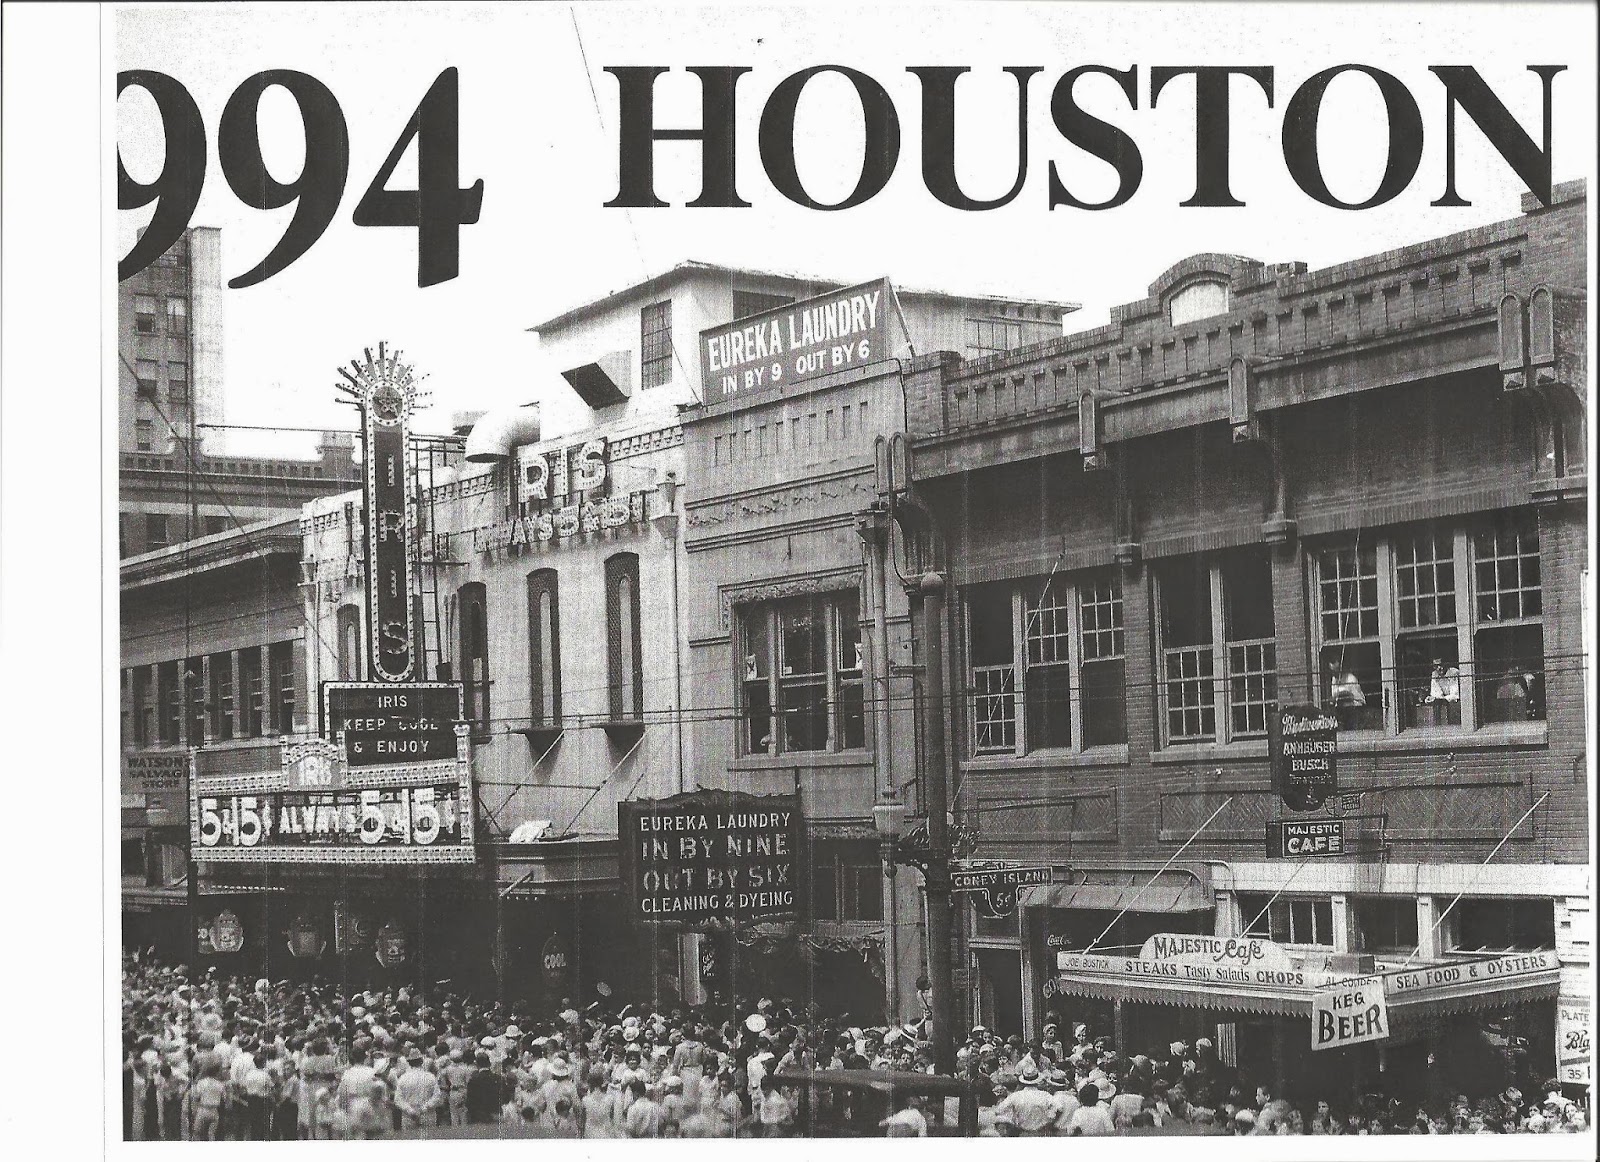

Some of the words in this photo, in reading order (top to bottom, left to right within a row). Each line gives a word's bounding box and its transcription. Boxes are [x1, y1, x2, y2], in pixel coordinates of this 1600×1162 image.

[708, 320, 783, 372] EUREKA
[788, 291, 880, 350] LAUNDRY
[722, 374, 738, 395] IN
[745, 367, 765, 390] BY
[771, 363, 782, 382] 9
[795, 350, 826, 375] OUT
[832, 342, 855, 367] BY
[858, 339, 870, 360] 6
[378, 695, 408, 709] IRIS
[343, 718, 386, 732] KEEP
[353, 741, 363, 753] &
[376, 740, 430, 753] ENJOY
[1283, 740, 1336, 755] ANHEUSER
[1291, 758, 1329, 771] BUSCH
[640, 815, 709, 832] EUREKA
[717, 812, 791, 830] LAUNDRY
[1288, 824, 1340, 835] MAJESTIC
[642, 837, 669, 861] IN
[679, 836, 713, 859] BY
[726, 833, 790, 857] NINE
[1288, 835, 1341, 853] CAFE
[643, 867, 696, 892] OUT
[706, 867, 739, 890] BY
[748, 862, 790, 888] SIX
[954, 873, 998, 887] CONEY
[1003, 870, 1049, 884] ISLAND
[641, 894, 719, 913] CLEANING
[724, 894, 735, 908] &
[739, 890, 793, 908] DYEING
[1153, 936, 1222, 960] MAJESTIC
[1125, 960, 1178, 976] STEAKS
[1184, 964, 1211, 980] Tasty
[1216, 966, 1250, 981] Salads
[1256, 970, 1304, 985] CHOPS
[1396, 974, 1421, 989] SEA
[1426, 967, 1460, 985] FOOD
[1469, 965, 1478, 978] &
[1487, 955, 1547, 975] OYSTERS
[1333, 991, 1365, 1010] KEG
[1318, 1003, 1383, 1044] BEER
[1561, 1009, 1590, 1022] PLATE
